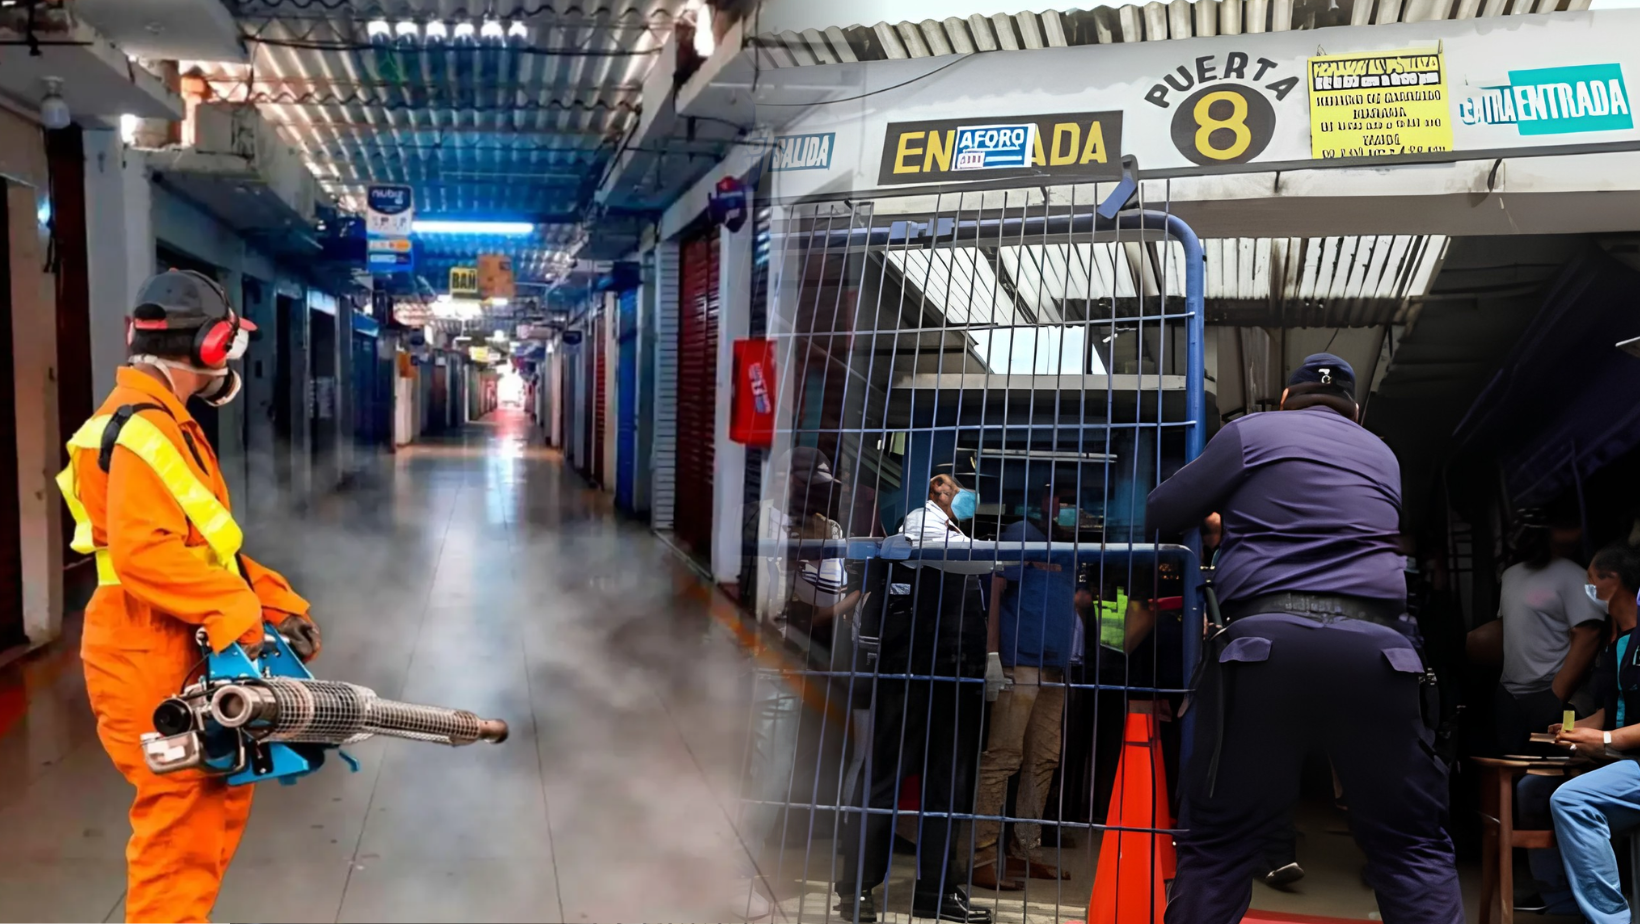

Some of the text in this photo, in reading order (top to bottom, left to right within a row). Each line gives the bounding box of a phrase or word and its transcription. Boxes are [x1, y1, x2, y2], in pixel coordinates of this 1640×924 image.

[1144, 52, 1299, 108] PUERTA
[1513, 79, 1628, 121] ENTRADA
[893, 121, 1107, 174] ENADA
[959, 128, 1024, 149] AFORO
[1193, 90, 1251, 160] 8
[772, 135, 829, 168] SALIDA
